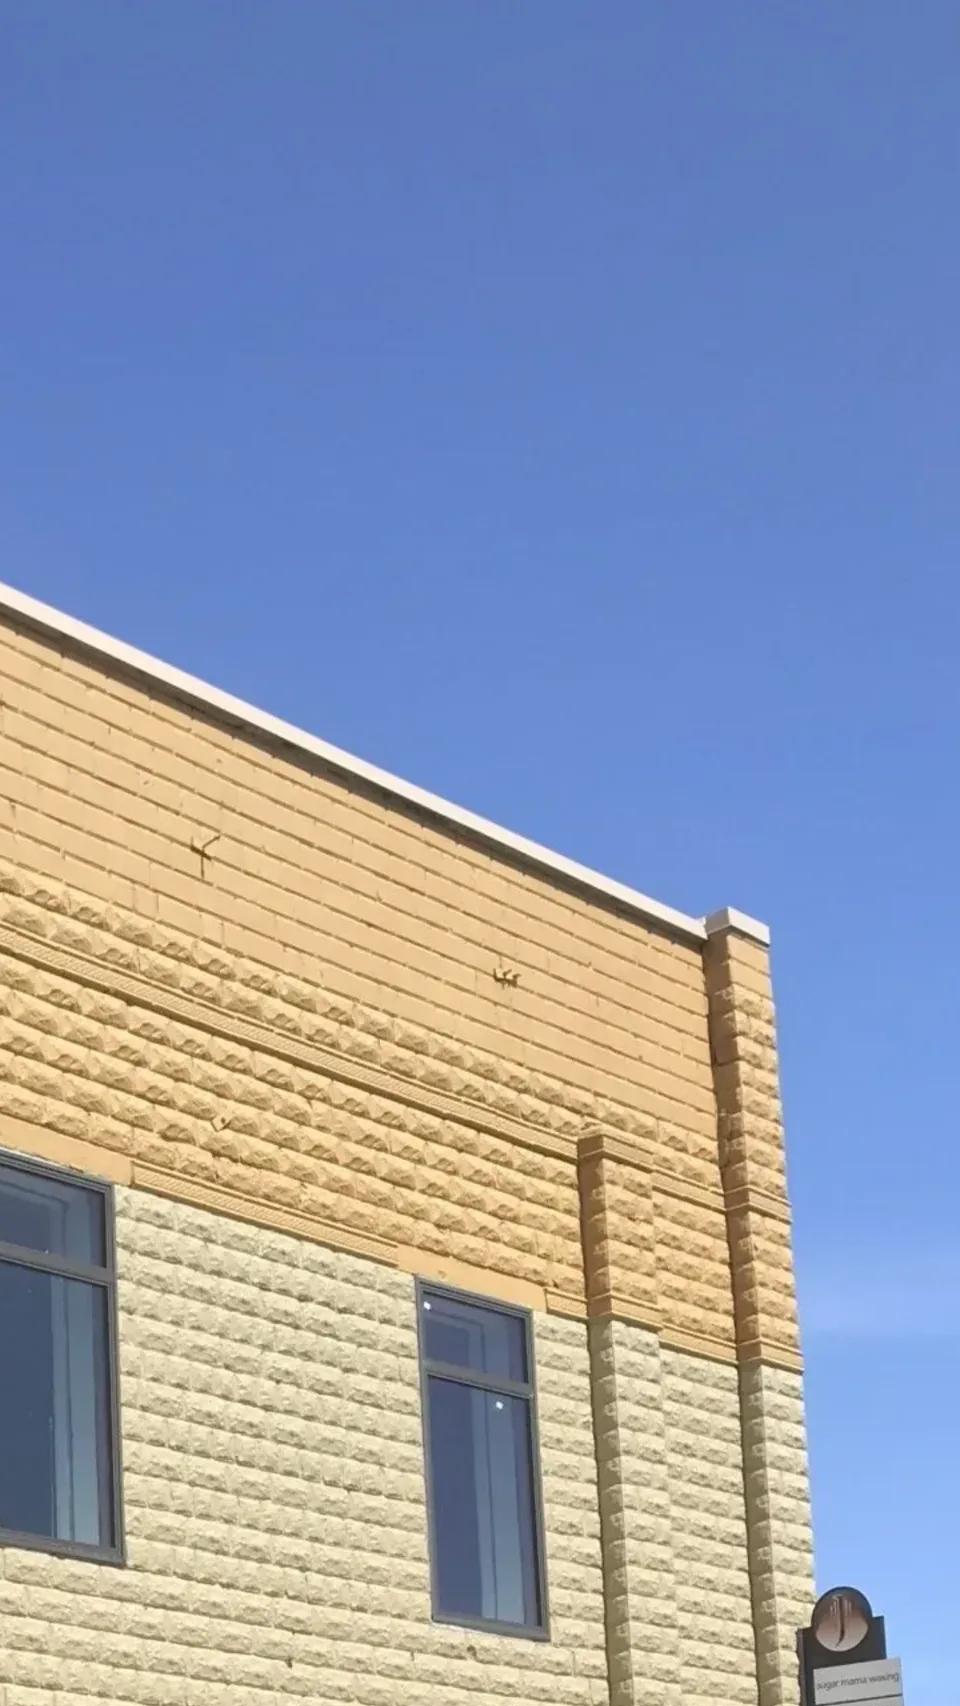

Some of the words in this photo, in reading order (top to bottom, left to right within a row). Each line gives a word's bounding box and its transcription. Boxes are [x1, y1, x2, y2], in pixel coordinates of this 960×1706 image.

[816, 1680, 839, 1691] sugar
[841, 1676, 868, 1686] mama
[869, 1672, 900, 1684] waxing
